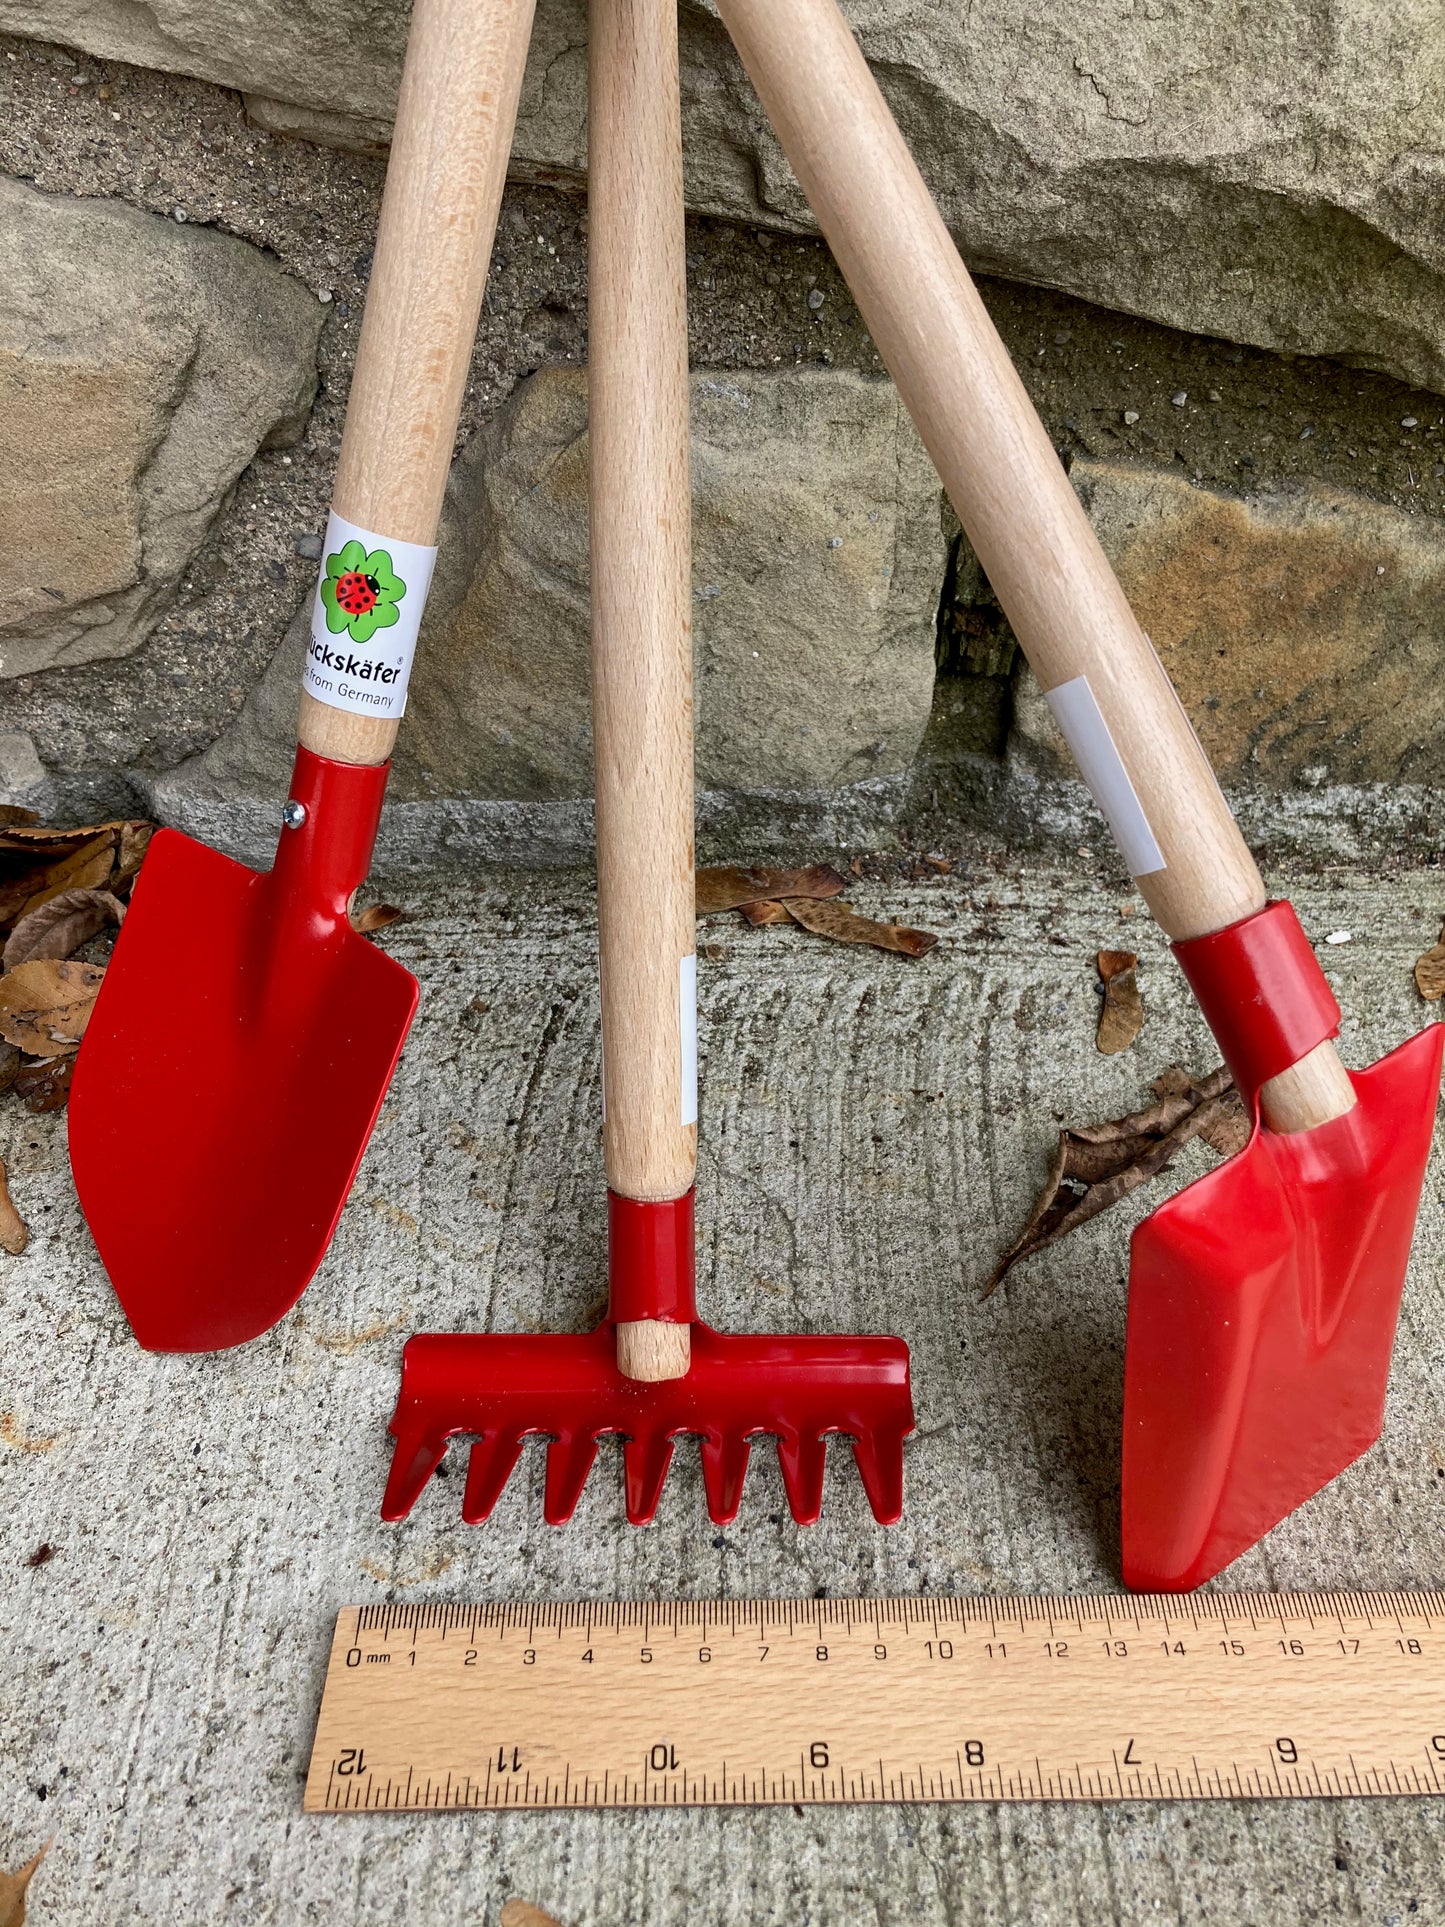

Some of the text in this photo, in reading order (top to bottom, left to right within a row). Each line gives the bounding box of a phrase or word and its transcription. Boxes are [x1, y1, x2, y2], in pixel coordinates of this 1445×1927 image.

[309, 632, 401, 684] ückskäfer
[310, 668, 333, 692] from
[338, 682, 394, 708] Germany
[346, 1638, 1423, 1667] 0 mm 1 2 3 4 5 6 7 8 9 10 11 12 13 14 15 16 17 18
[337, 1748, 367, 1776] 12
[497, 1746, 522, 1773] 11
[650, 1744, 680, 1771] 10
[810, 1742, 829, 1769] 9
[964, 1740, 985, 1766] 8
[1123, 1738, 1142, 1765] 7
[1275, 1737, 1298, 1764] 6
